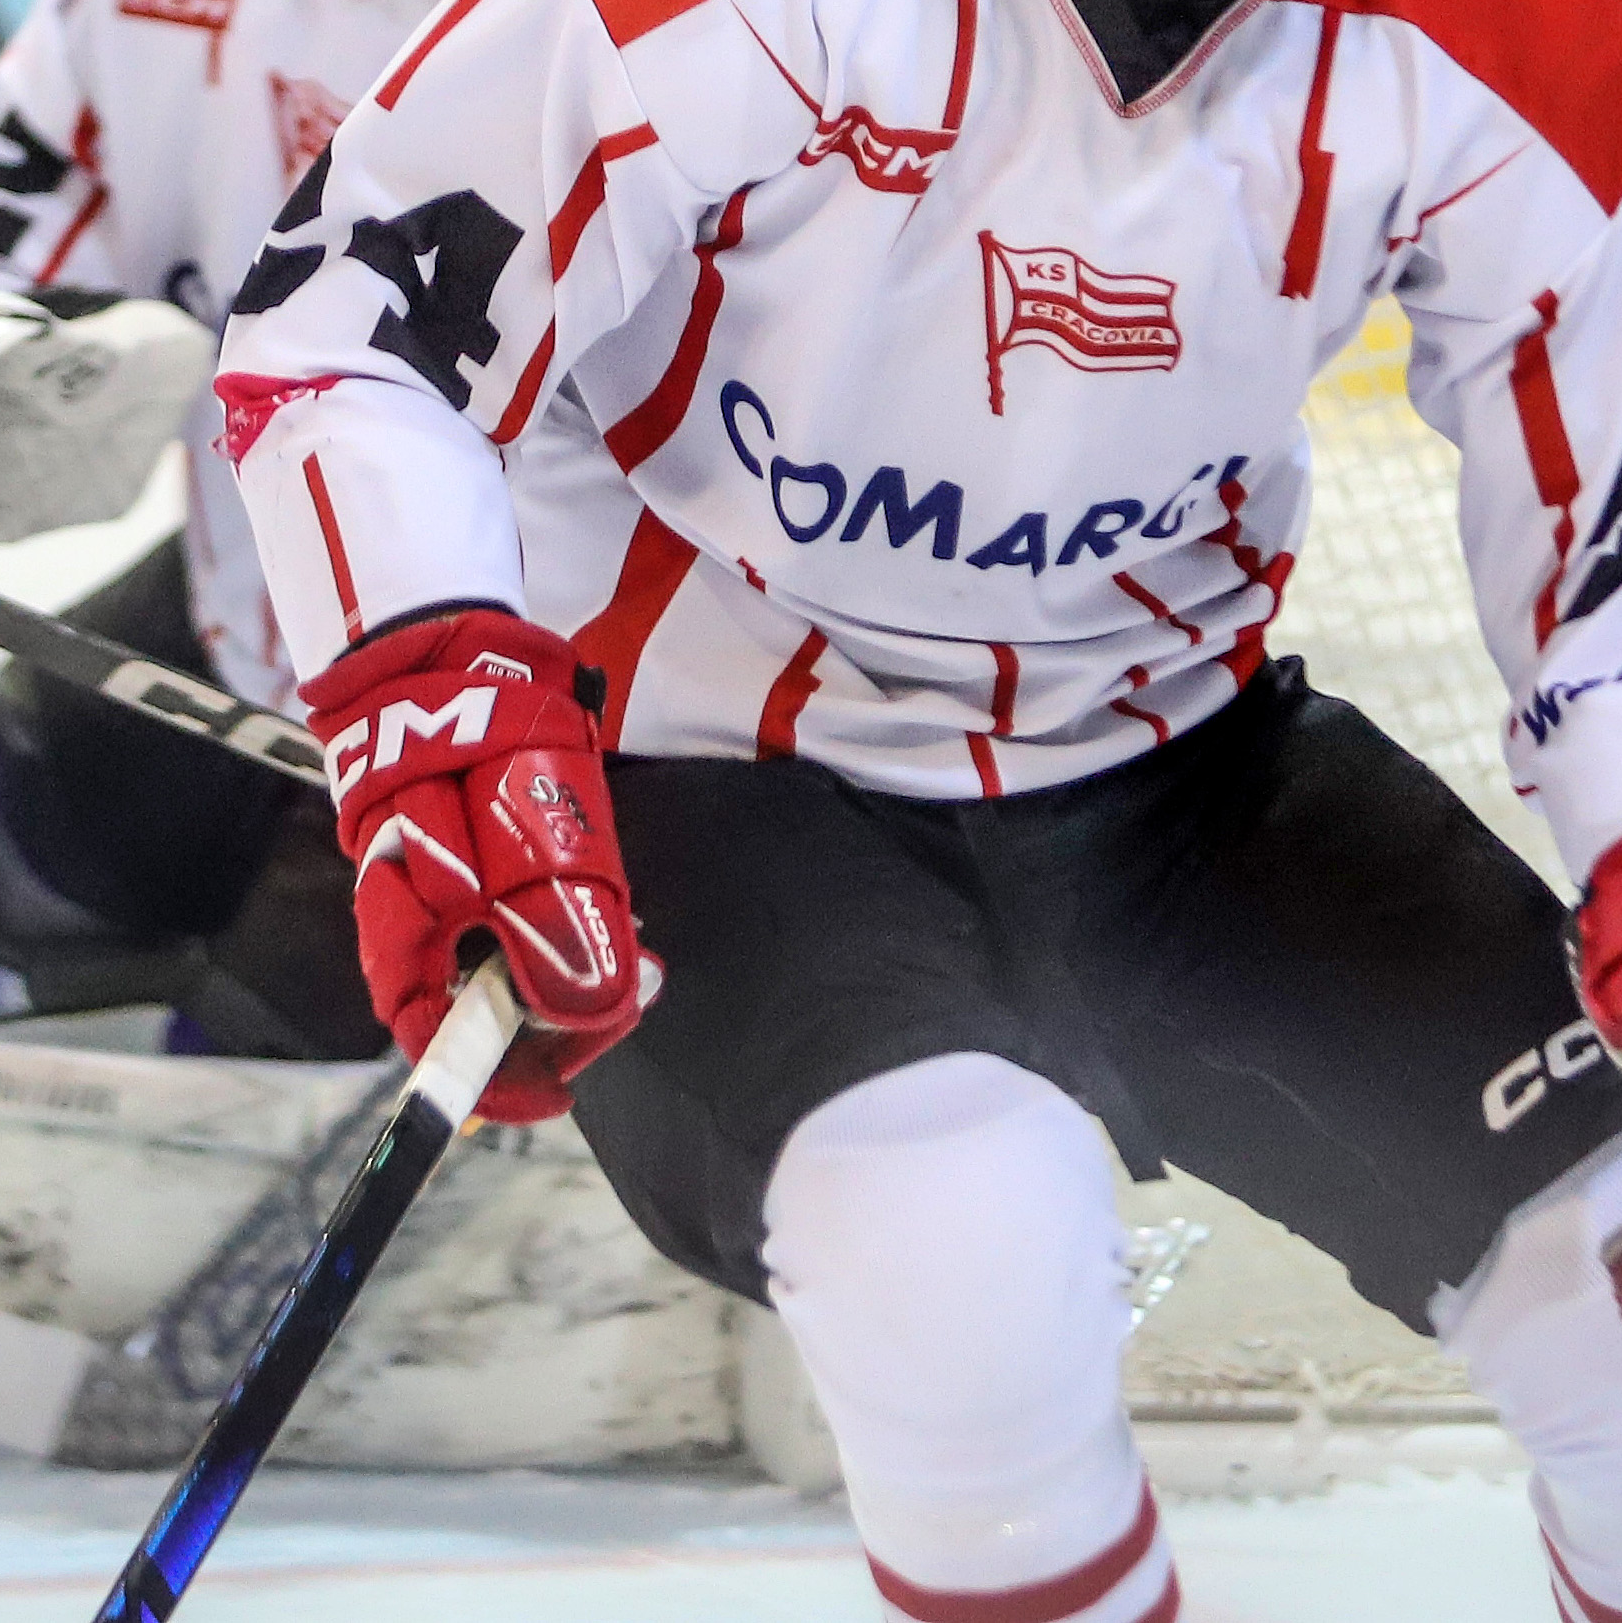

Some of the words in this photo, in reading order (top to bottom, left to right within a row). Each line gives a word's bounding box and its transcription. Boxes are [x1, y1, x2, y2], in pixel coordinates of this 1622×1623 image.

[1026, 262, 1067, 282] KS
[1030, 301, 1165, 345] CRACOVIA
[324, 686, 499, 815] CM
